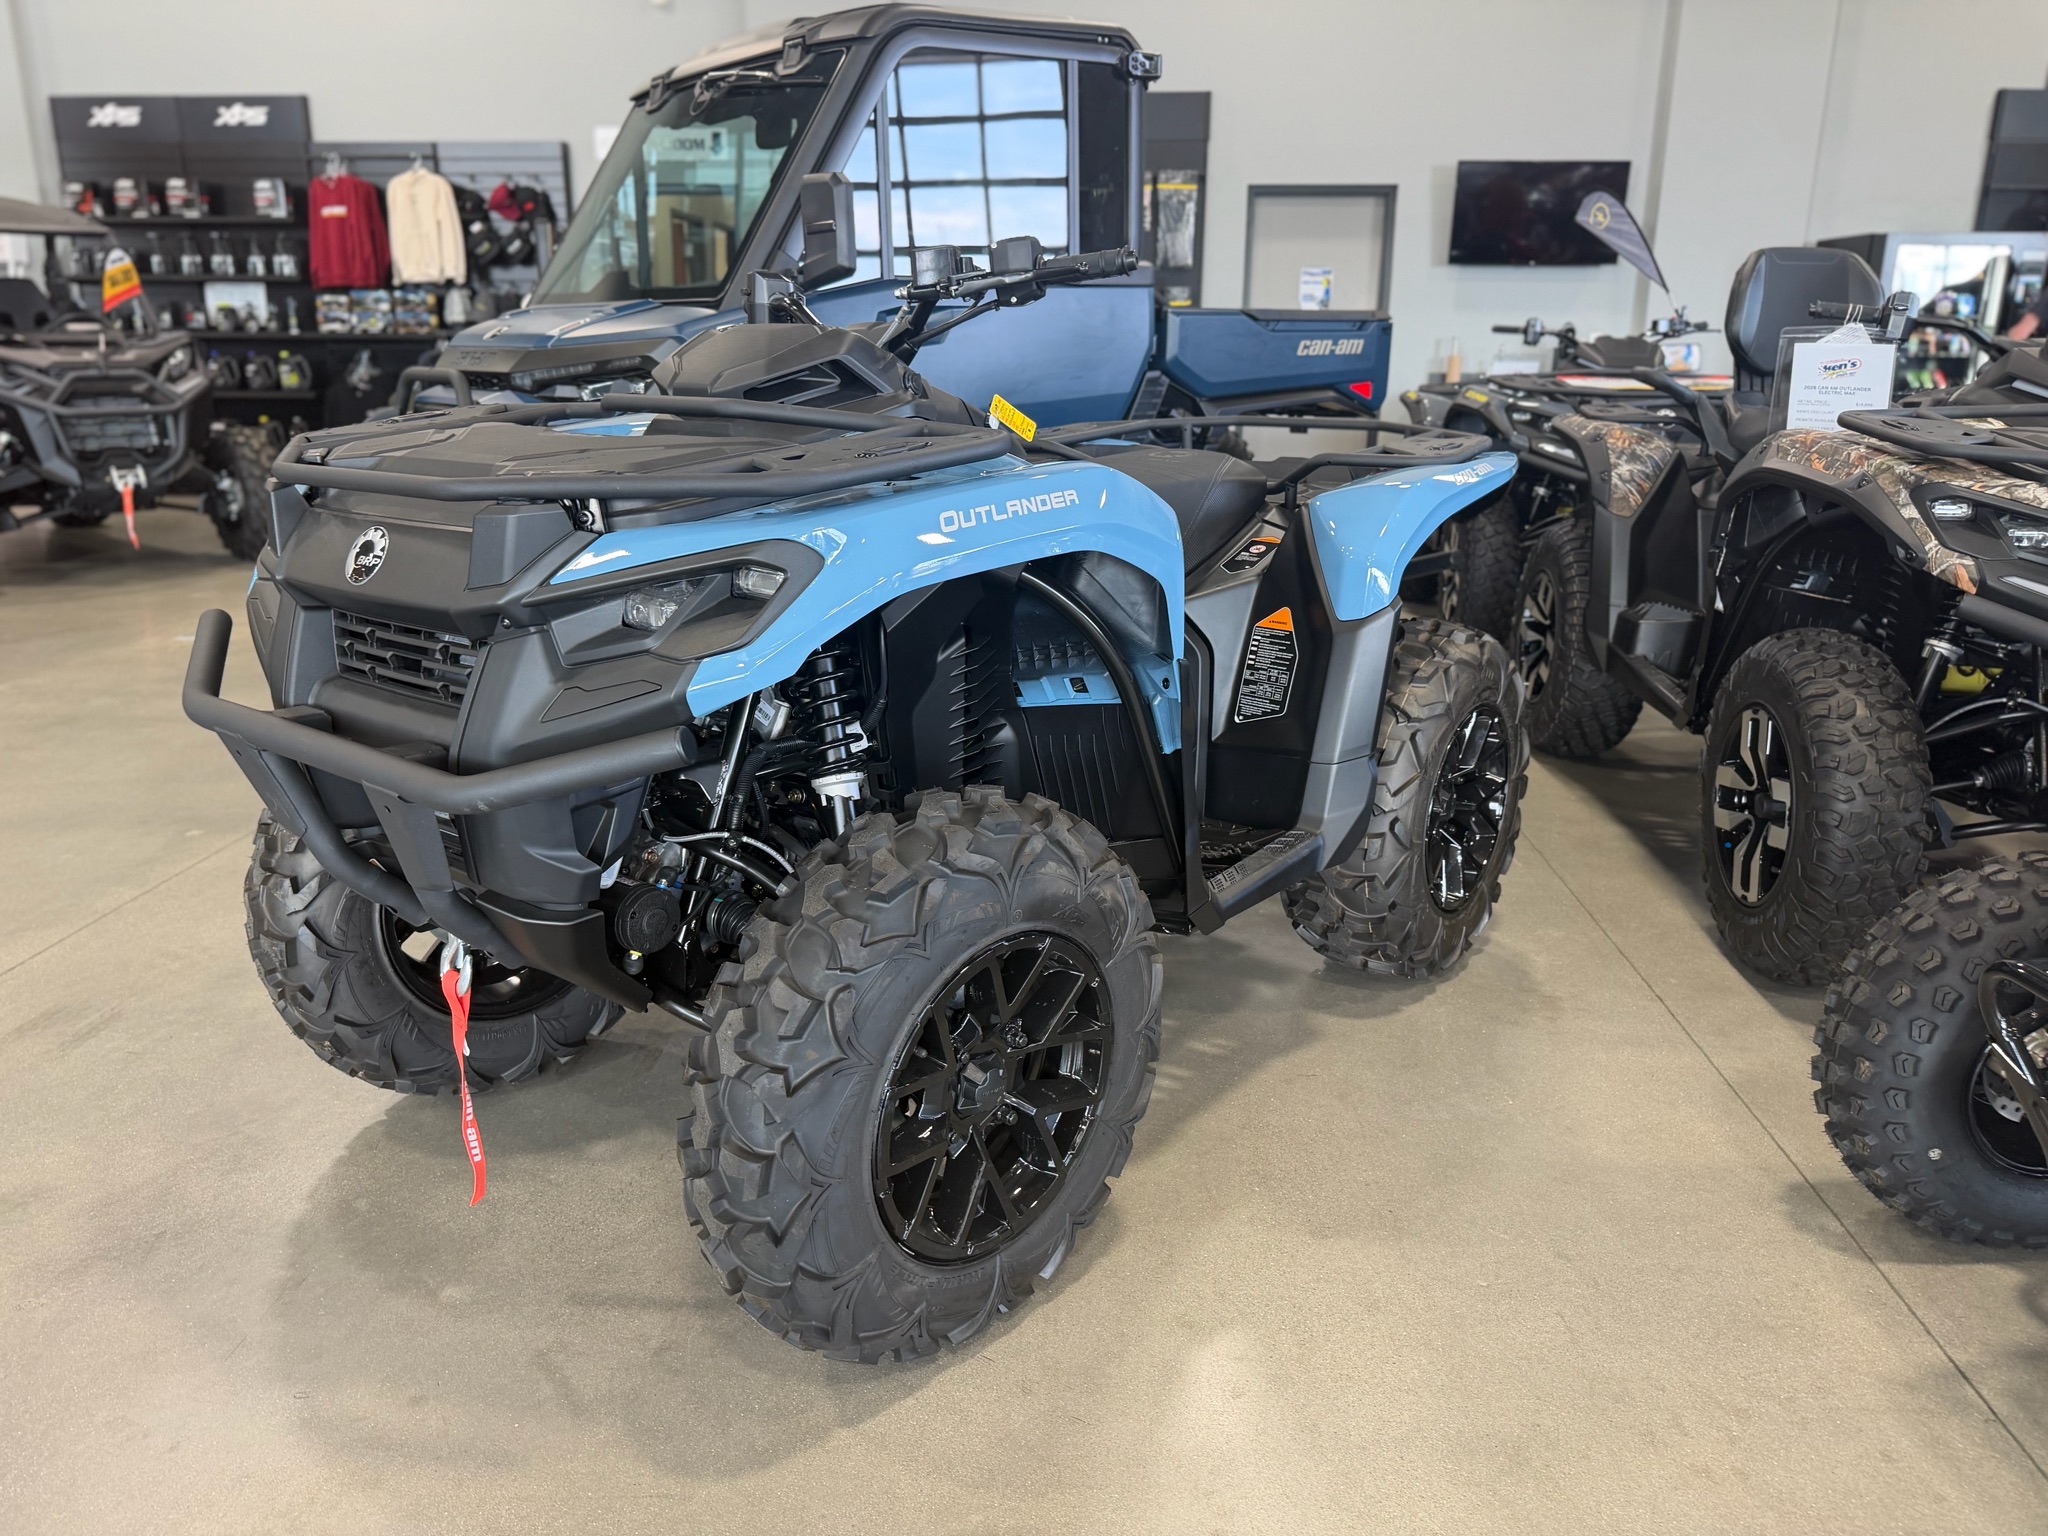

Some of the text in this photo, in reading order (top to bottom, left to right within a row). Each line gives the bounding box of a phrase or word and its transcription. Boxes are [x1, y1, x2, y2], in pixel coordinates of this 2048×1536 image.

[1296, 338, 1364, 356] can-am
[939, 489, 1080, 533] OUTLANDER
[355, 555, 381, 567] BRP
